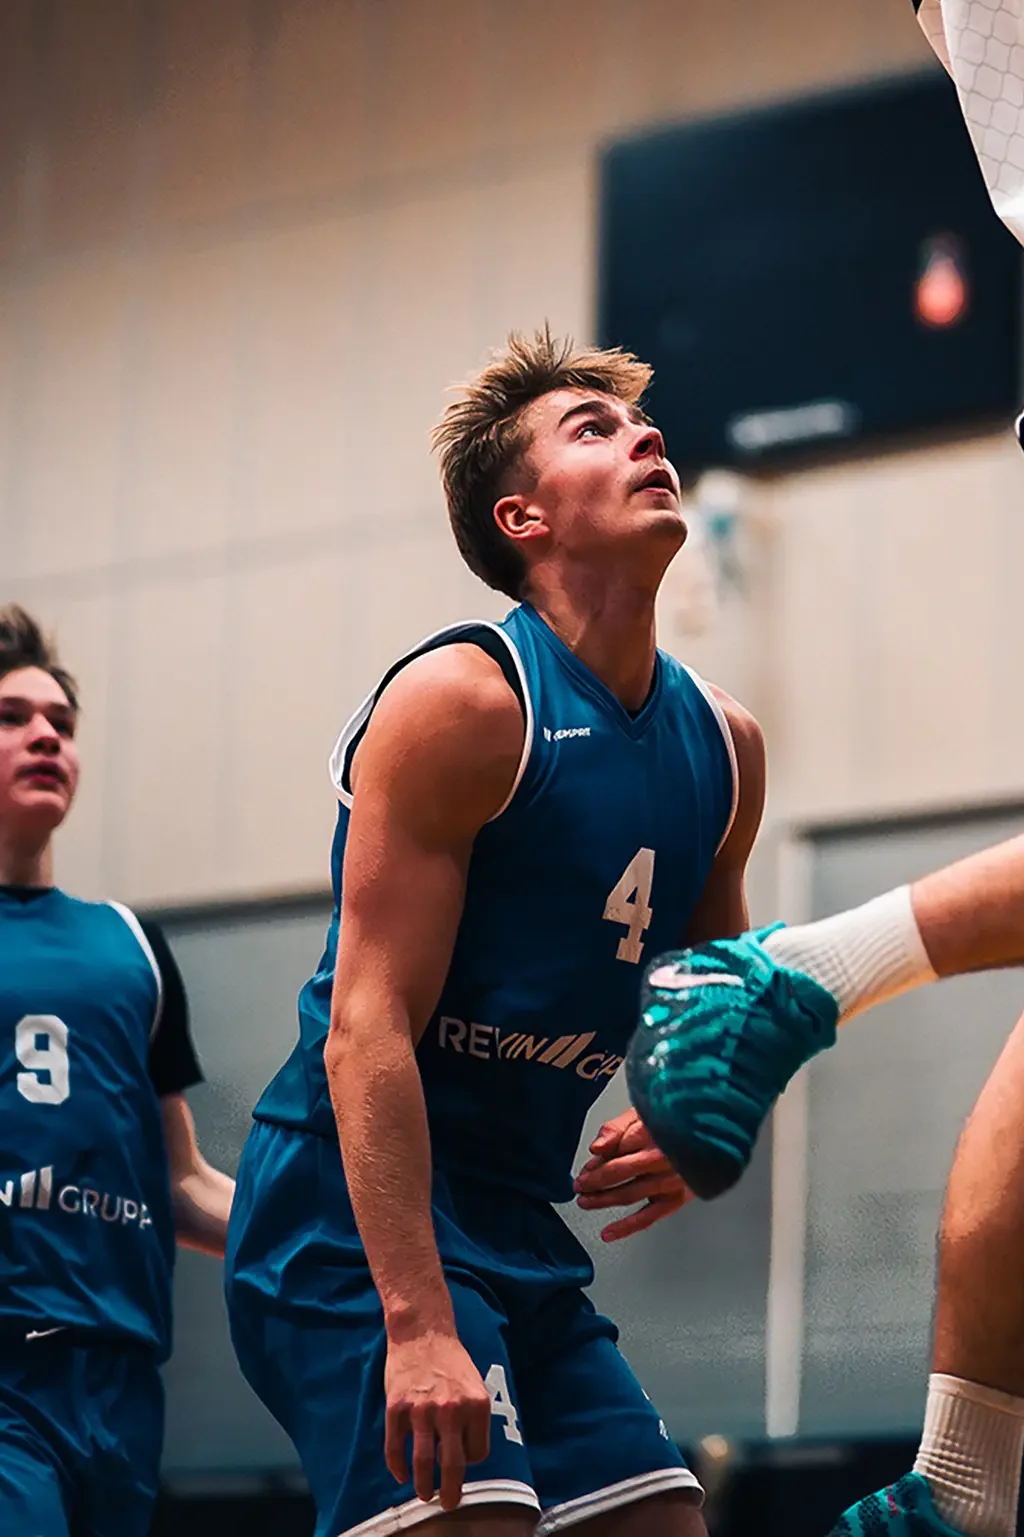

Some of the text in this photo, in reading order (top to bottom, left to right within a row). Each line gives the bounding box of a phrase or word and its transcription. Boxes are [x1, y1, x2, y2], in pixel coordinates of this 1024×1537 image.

[602, 847, 655, 964] 4
[15, 1014, 70, 1105] 9
[438, 1015, 549, 1061] REVIN
[484, 1364, 524, 1446] 4
